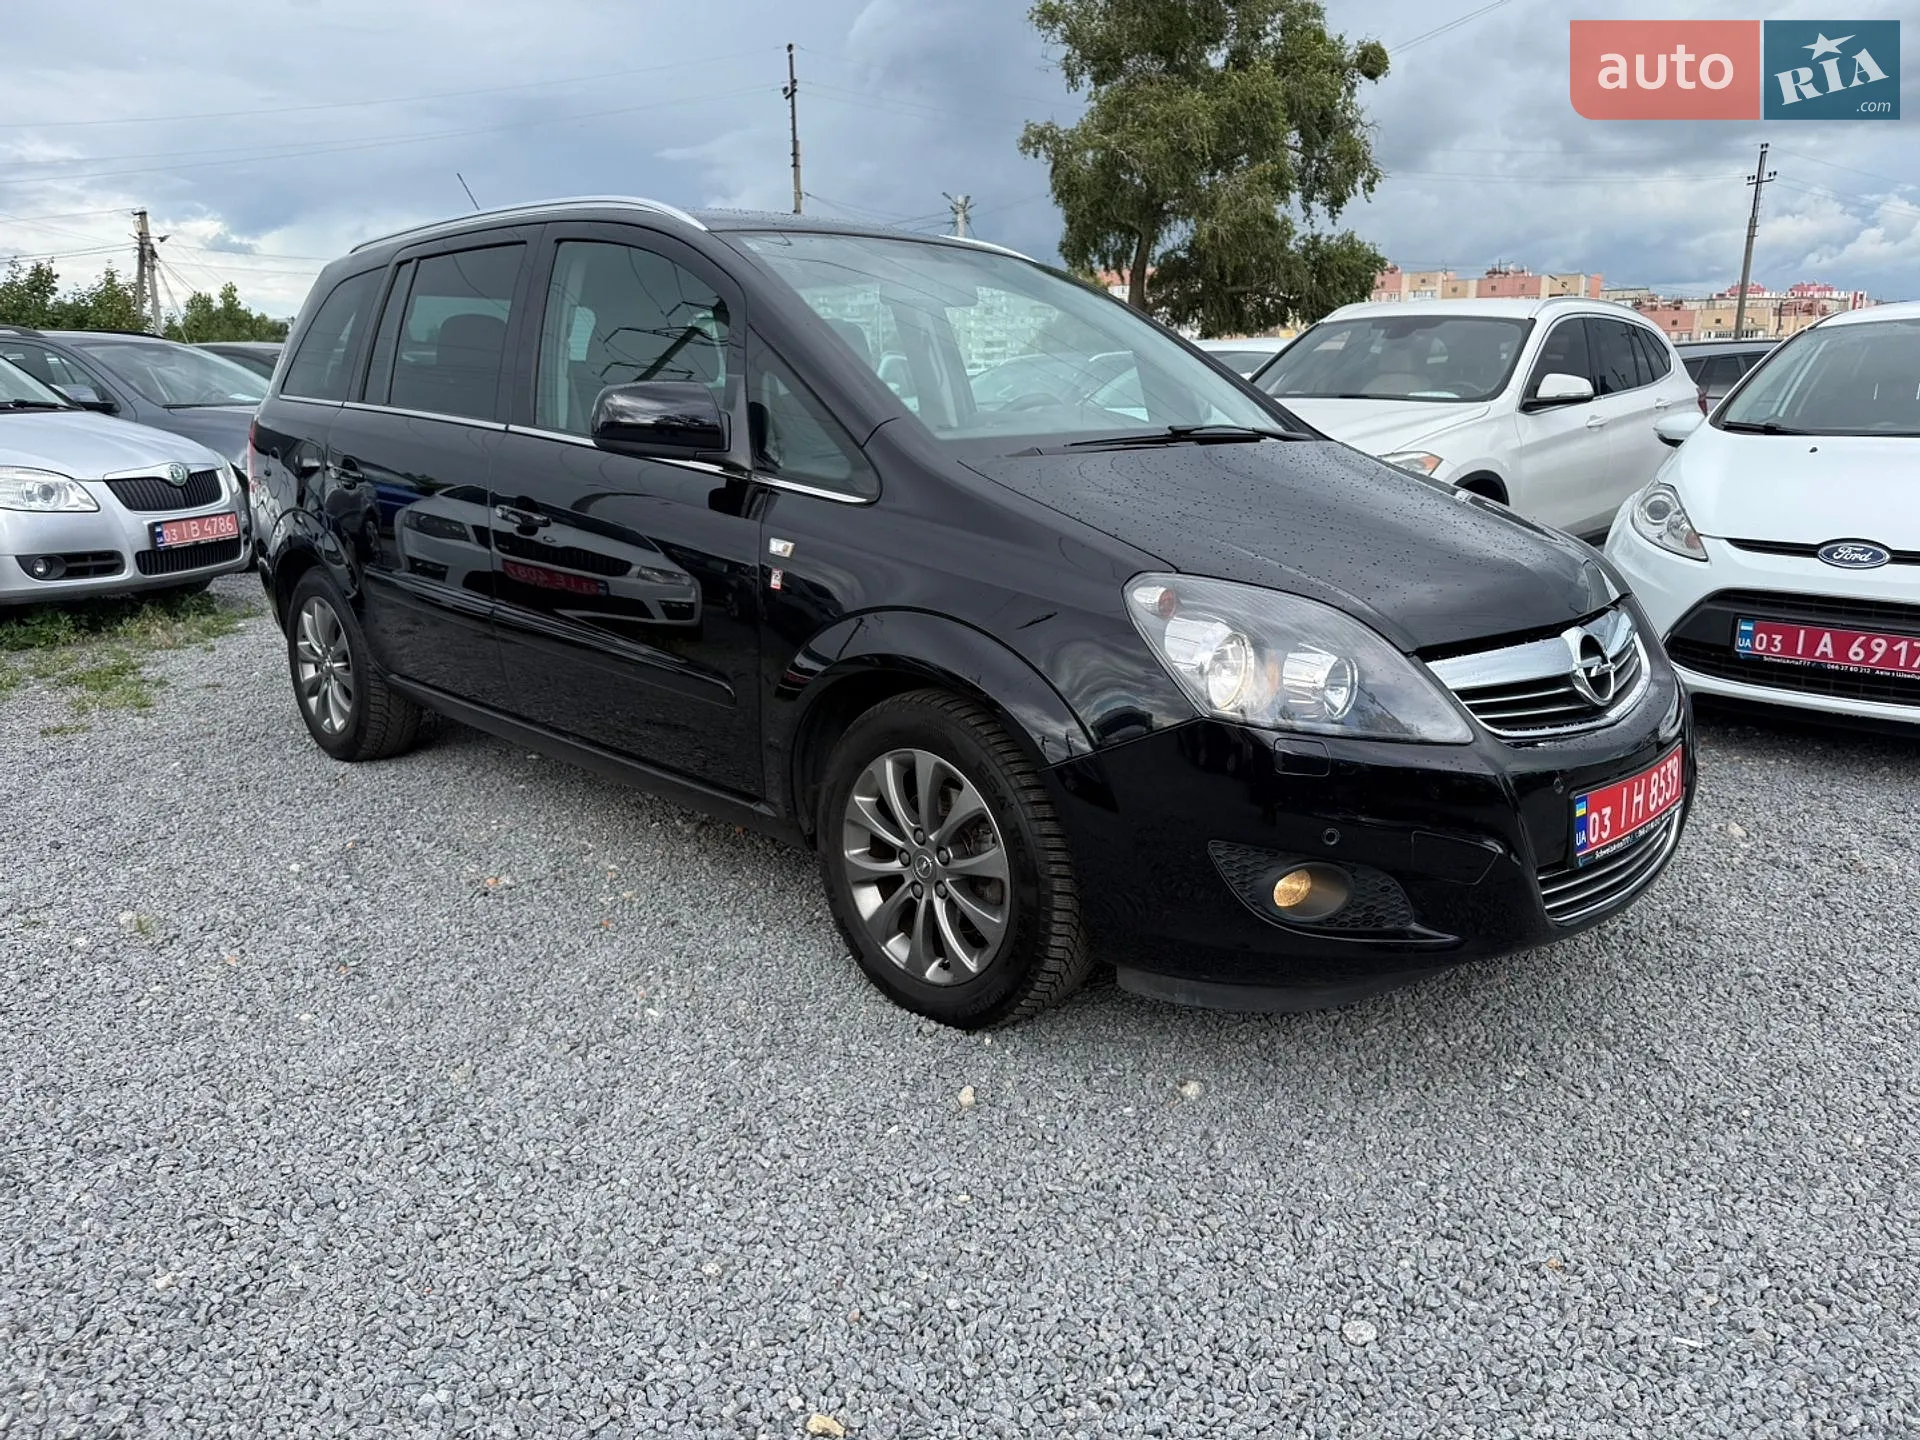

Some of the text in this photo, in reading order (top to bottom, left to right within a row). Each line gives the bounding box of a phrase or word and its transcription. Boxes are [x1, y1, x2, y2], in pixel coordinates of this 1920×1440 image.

[163, 528, 178, 542] 03
[182, 521, 200, 539] IB
[204, 516, 234, 535] 4786
[1832, 546, 1873, 562] Ford
[1738, 637, 1752, 648] UA
[1754, 630, 1920, 668] 03 IA 6917
[1589, 806, 1612, 843] 03
[1620, 778, 1646, 829] IH
[1649, 755, 1679, 812] 8539
[1575, 830, 1587, 846] UA
